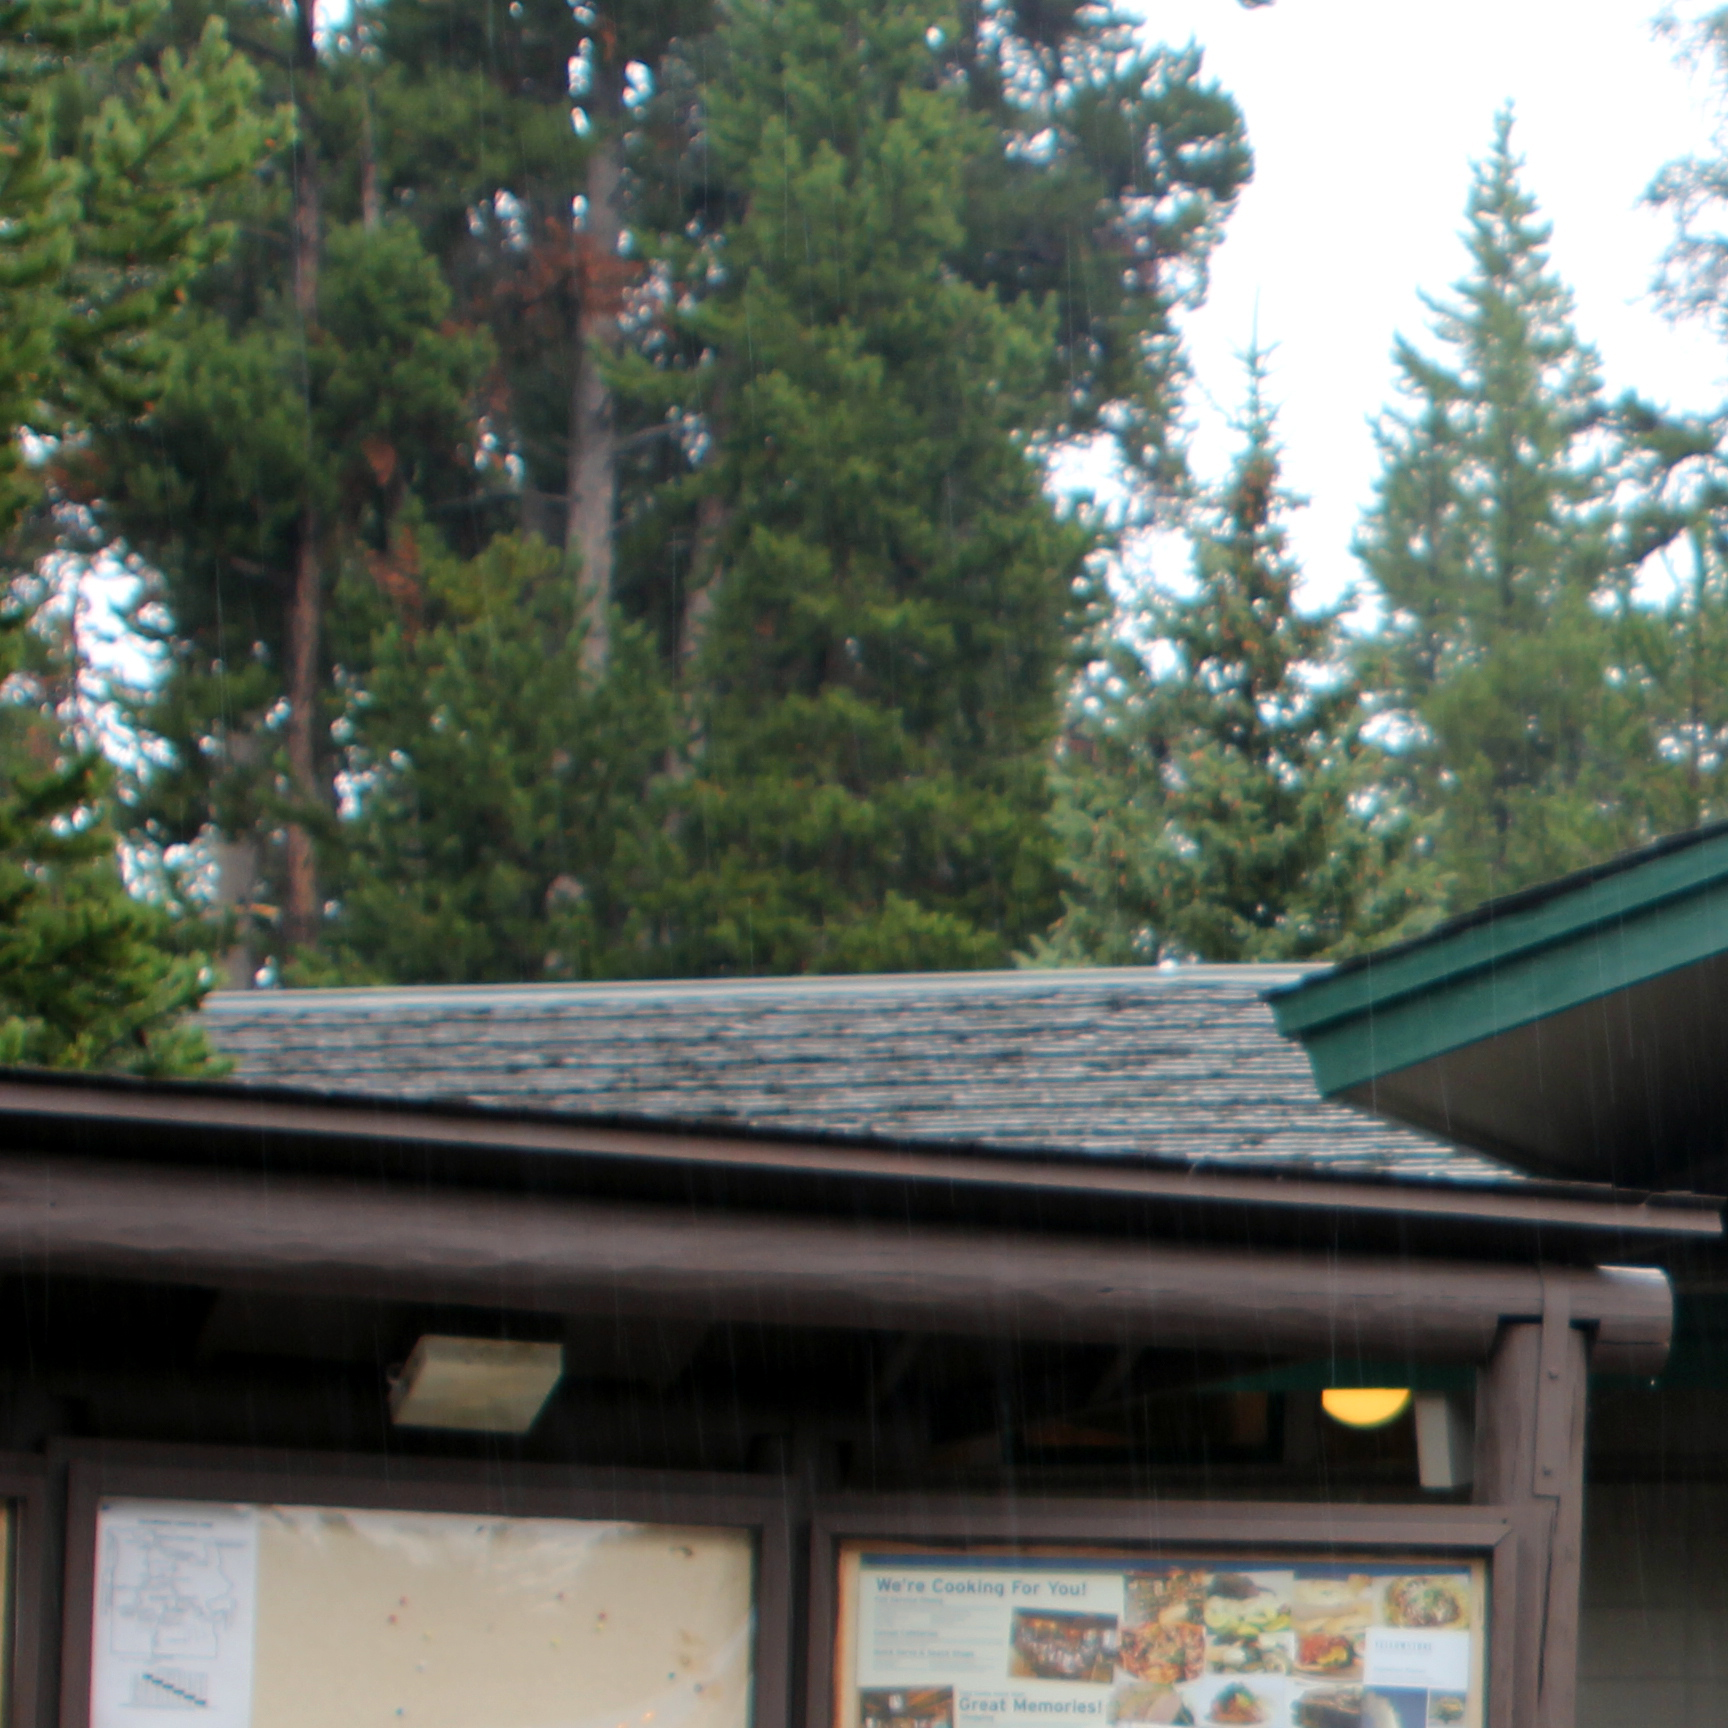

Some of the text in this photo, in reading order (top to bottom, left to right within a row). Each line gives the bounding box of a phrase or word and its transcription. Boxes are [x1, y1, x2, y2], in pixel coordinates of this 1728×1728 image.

[876, 1577, 1087, 1597] We're Cooking For You!
[959, 1698, 1103, 1714] Great Memories!
